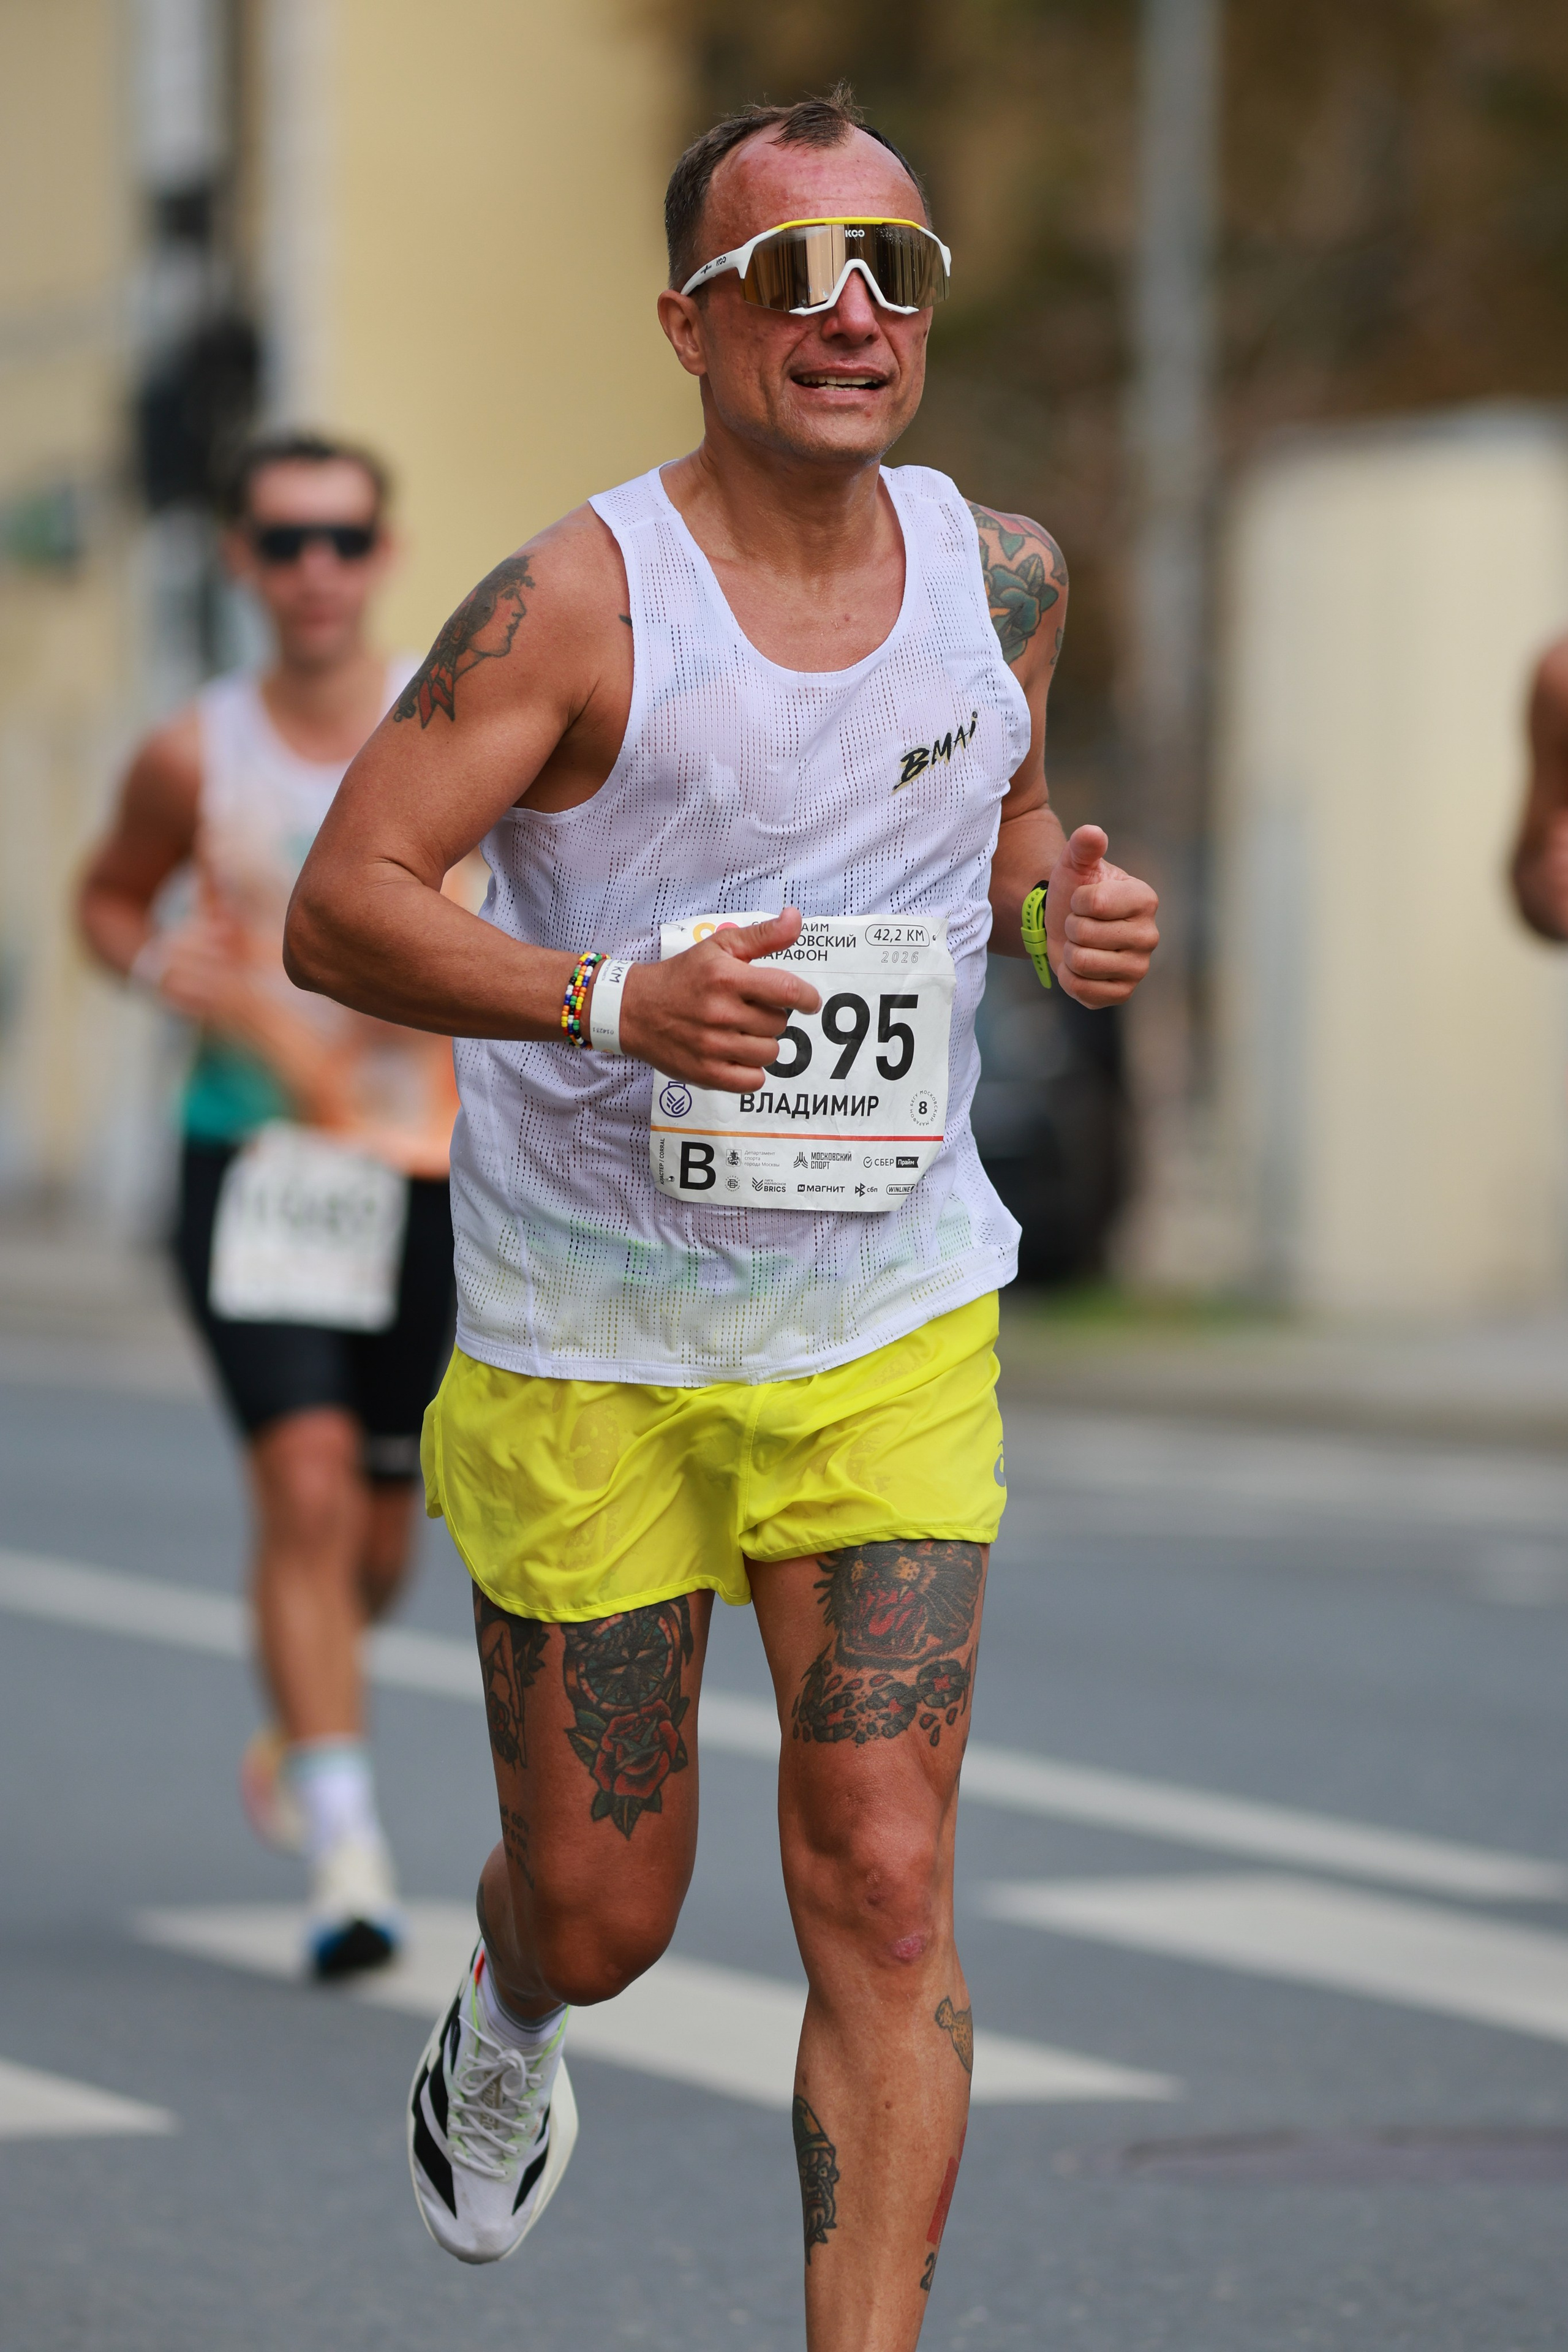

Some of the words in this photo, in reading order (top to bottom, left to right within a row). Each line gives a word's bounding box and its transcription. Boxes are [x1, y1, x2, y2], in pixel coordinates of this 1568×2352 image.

[845, 229, 865, 238] KOO
[801, 922, 829, 932] АЙМ
[793, 934, 856, 948] ОВСКИЙ
[873, 929, 902, 943] 42,2
[758, 949, 827, 961] АРАФОН
[881, 951, 919, 963] 2026
[762, 992, 919, 1080] 695
[740, 1092, 879, 1119] ВЛАДИМИР
[919, 1101, 927, 1114] 8
[811, 1152, 852, 1161] МОСКОВСКИЙ
